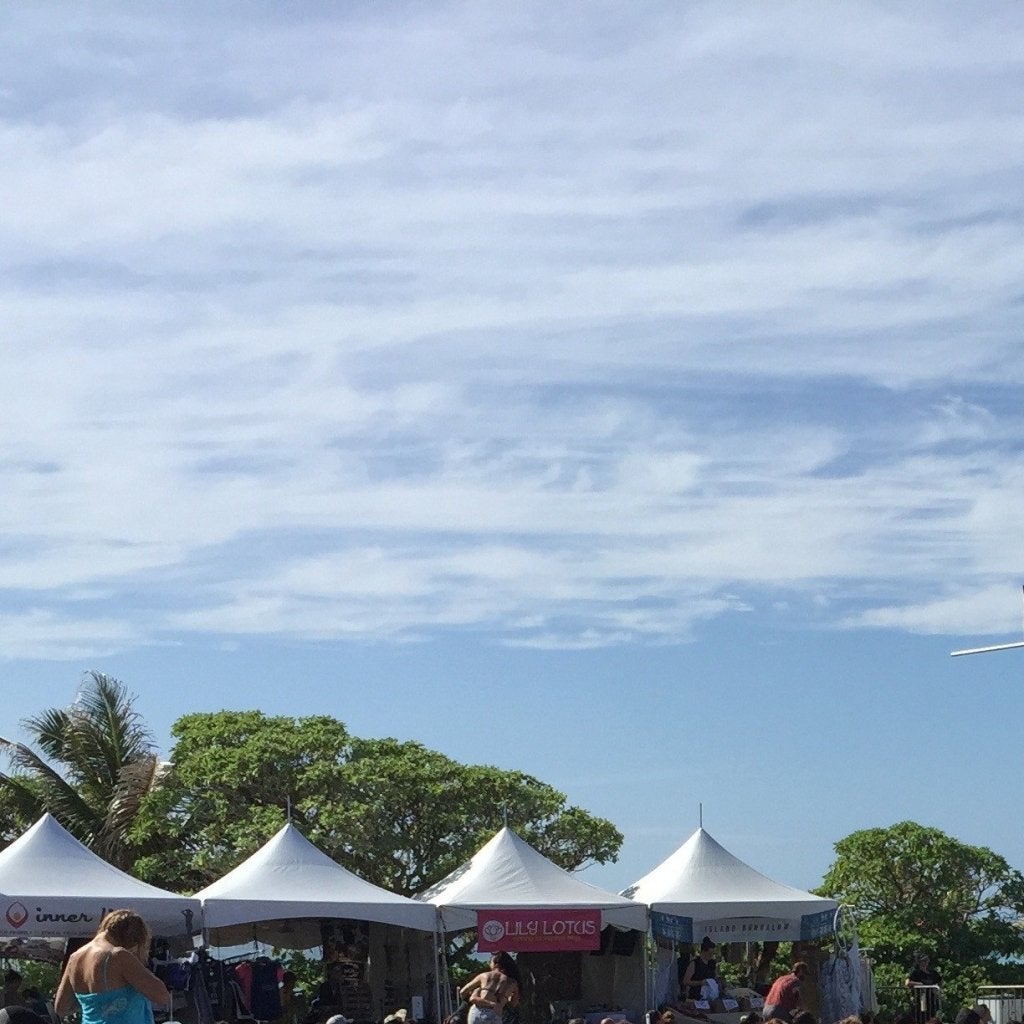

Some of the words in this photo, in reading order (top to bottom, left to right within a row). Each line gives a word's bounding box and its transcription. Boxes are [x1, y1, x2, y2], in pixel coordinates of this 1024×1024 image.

[35, 907, 93, 923] inner
[505, 920, 538, 936] LILY
[543, 920, 596, 935] LOTUS
